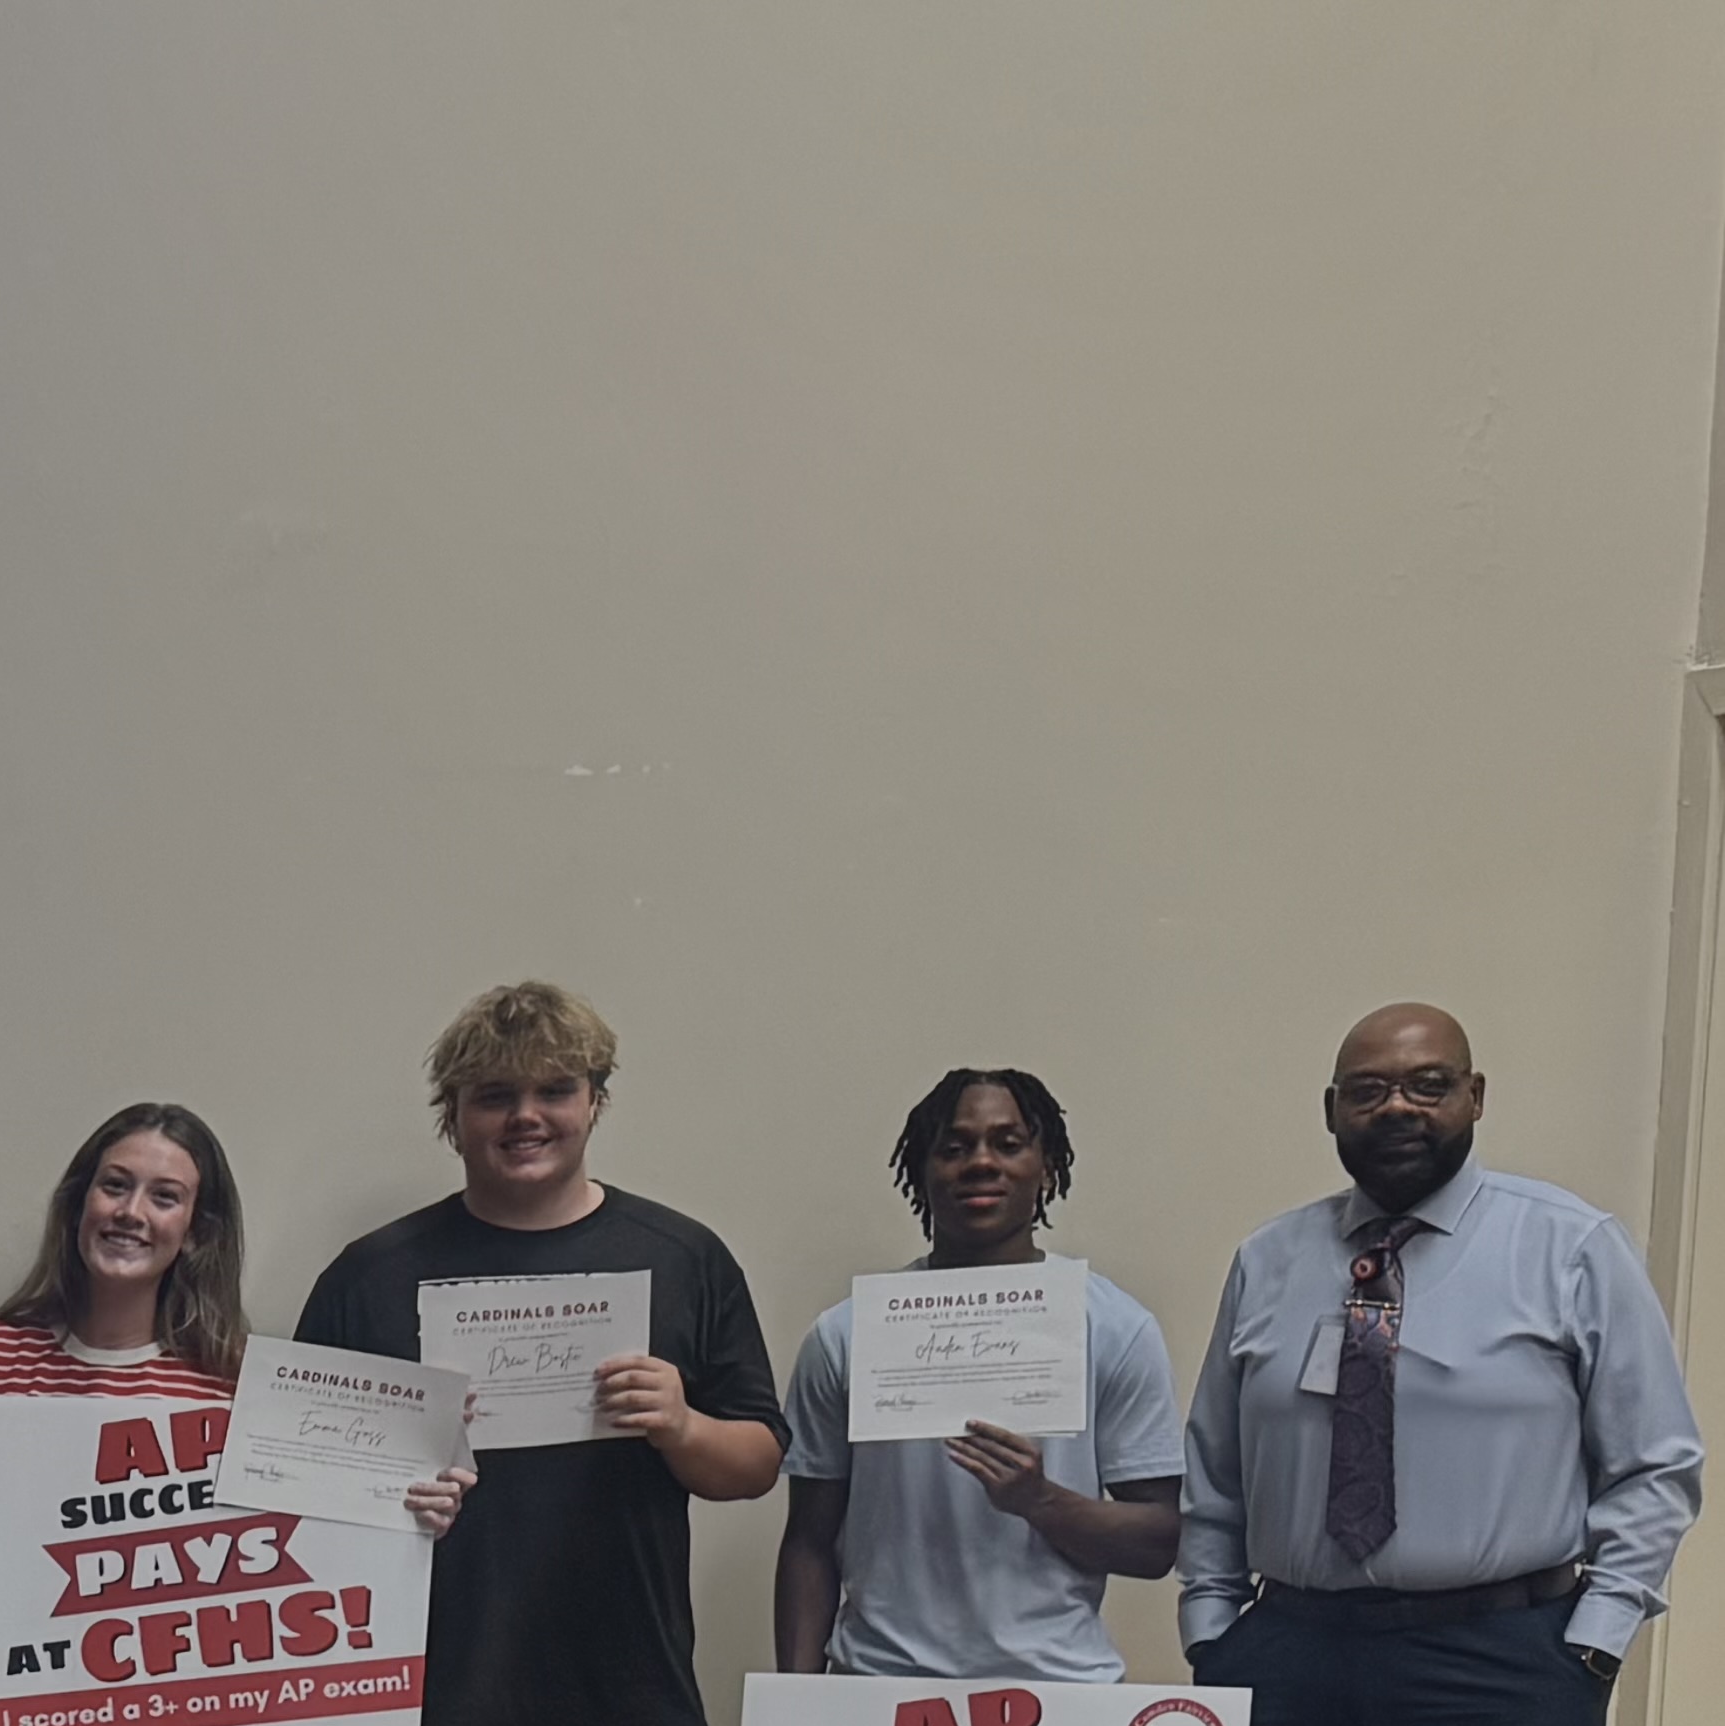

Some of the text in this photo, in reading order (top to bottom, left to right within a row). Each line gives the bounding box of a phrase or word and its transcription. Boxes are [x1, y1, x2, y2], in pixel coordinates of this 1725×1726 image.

[456, 1300, 610, 1323] CARDINALS SOAR
[888, 1289, 1044, 1311] CARDINALS SOAR
[276, 1366, 426, 1401] CARDINALS SOAR
[94, 1407, 232, 1484] AP
[60, 1479, 214, 1529] SUCCE
[75, 1526, 281, 1598] PAYS
[6, 1584, 375, 1683] AT CFHS!
[122, 1698, 142, 1720] a
[148, 1694, 180, 1719] 3+
[186, 1692, 222, 1714] on
[228, 1687, 270, 1714] my
[277, 1679, 316, 1704] AP
[323, 1665, 412, 1699] exam!
